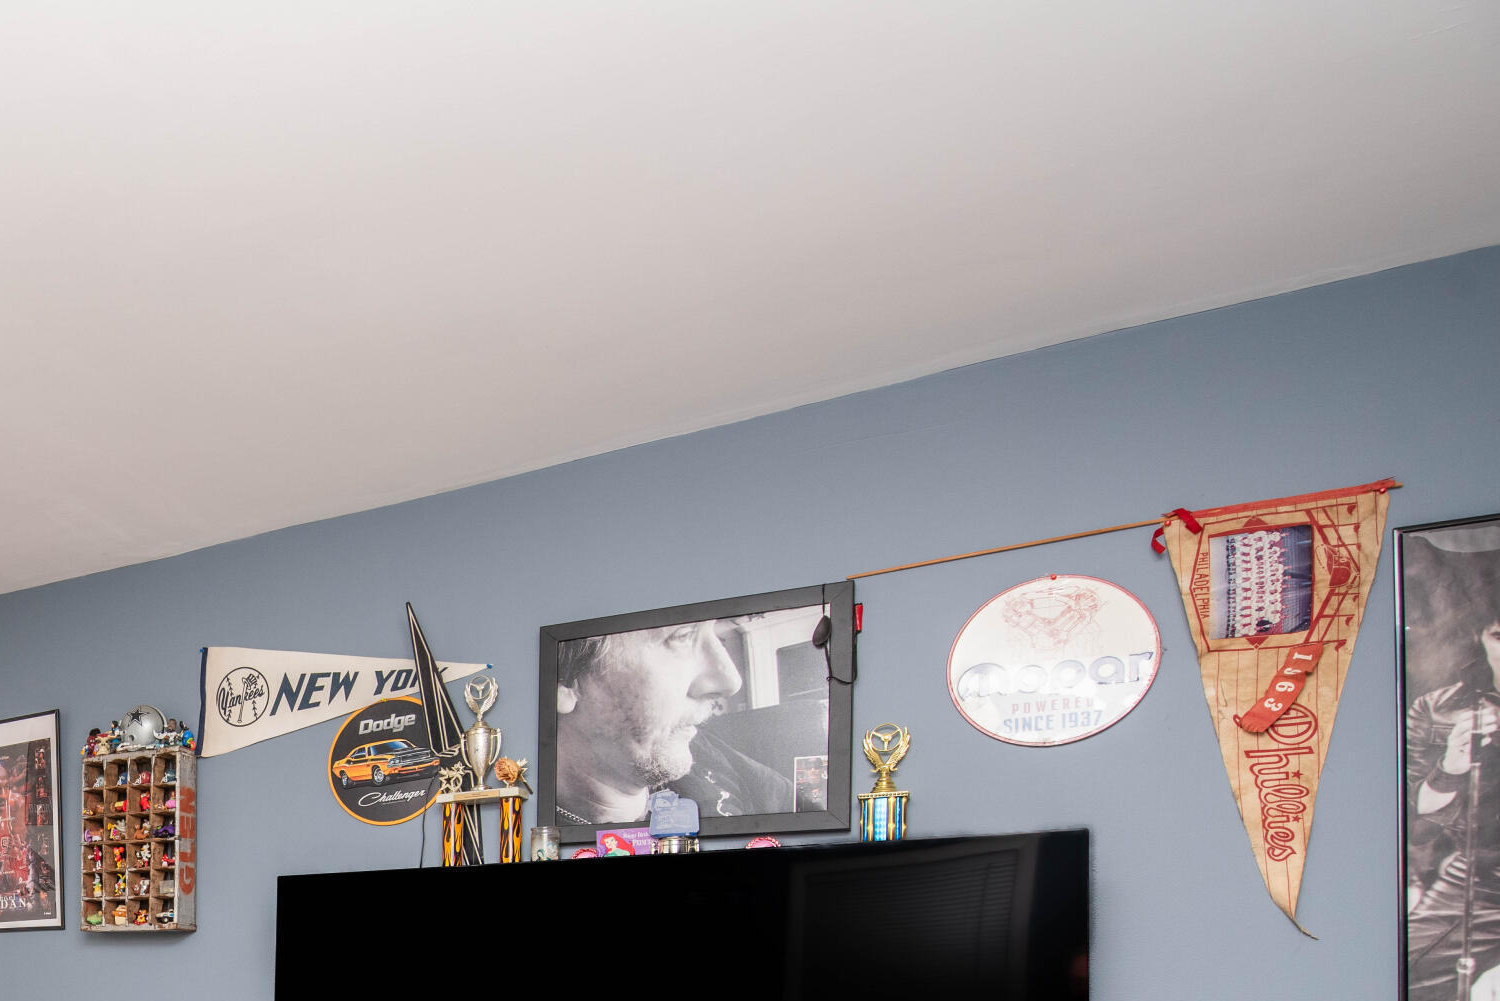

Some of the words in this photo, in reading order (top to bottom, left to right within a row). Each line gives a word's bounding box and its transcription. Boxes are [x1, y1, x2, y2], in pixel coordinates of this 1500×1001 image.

[1199, 551, 1209, 620] PHILADELPHIA
[269, 671, 360, 717] NEW
[373, 666, 448, 696] YO
[358, 713, 416, 735] Dodge
[1003, 714, 1056, 735] SINCE
[1061, 709, 1104, 730] 1937
[358, 788, 427, 807] Challenger
